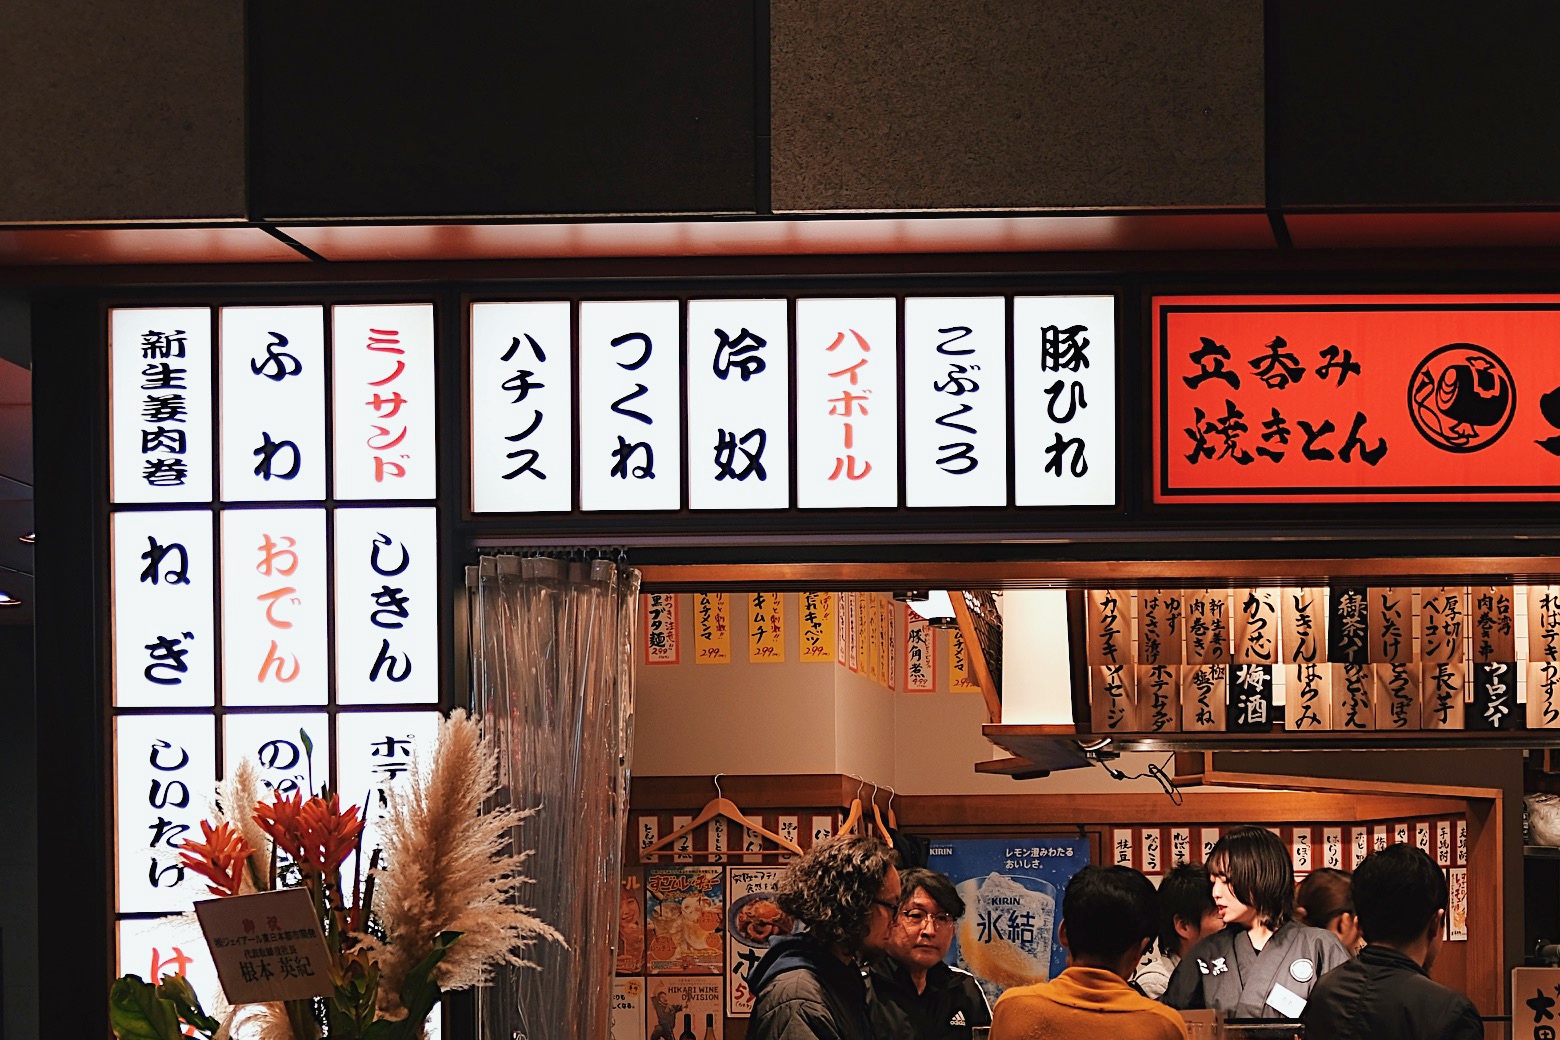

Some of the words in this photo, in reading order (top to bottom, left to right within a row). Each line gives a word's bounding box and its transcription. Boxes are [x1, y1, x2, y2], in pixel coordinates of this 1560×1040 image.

[1183, 336, 1360, 390] 立呑み
[141, 330, 188, 486] 新生姜肉巻
[251, 332, 302, 481] ふわ
[366, 329, 410, 482] ミノサンド
[500, 333, 546, 480] ハチノス
[611, 332, 655, 479] つくね
[713, 328, 767, 481] 冷奴
[826, 329, 872, 480] ハイボール
[934, 326, 981, 475] こぶくろ
[1040, 325, 1090, 478] 豚ひれ
[1184, 399, 1387, 466] 焼きとん
[140, 536, 194, 685] ねぎ
[257, 534, 300, 682] おでん
[369, 532, 411, 682] しきん
[649, 593, 666, 648] 黒ブタ麺
[751, 593, 767, 644] キムチ
[1099, 597, 1121, 663] カクテキ
[1164, 598, 1181, 635] ゆず
[1189, 599, 1210, 657] 肉巻き
[1209, 599, 1226, 659] 新生姜の
[1292, 595, 1317, 663] しきん
[1338, 594, 1368, 662] 緑茶ハイ
[1381, 595, 1402, 661] しいたけ
[1423, 597, 1442, 657] ベーコン
[1441, 596, 1462, 660] 厚切り
[1477, 595, 1496, 661] 肉巻き串
[1497, 595, 1512, 636] 台湾
[908, 629, 925, 678] 豚角煮
[1209, 665, 1225, 680] 極
[1106, 665, 1125, 729] ソーセージ
[1193, 669, 1215, 726] 塩つくね
[1236, 665, 1270, 724] 梅酒
[1295, 663, 1322, 729] はらみ
[1342, 663, 1369, 729] のどぶえ
[1430, 663, 1458, 724] 長芋
[1484, 662, 1509, 727] ウーロンハイ
[1541, 662, 1560, 724] うずら
[149, 738, 190, 887] しいたけ
[1006, 848, 1073, 857] レモン澄みわたる
[1006, 859, 1044, 869] おいしさ。
[977, 910, 1035, 944] 氷結
[991, 897, 1021, 905] KIRIN
